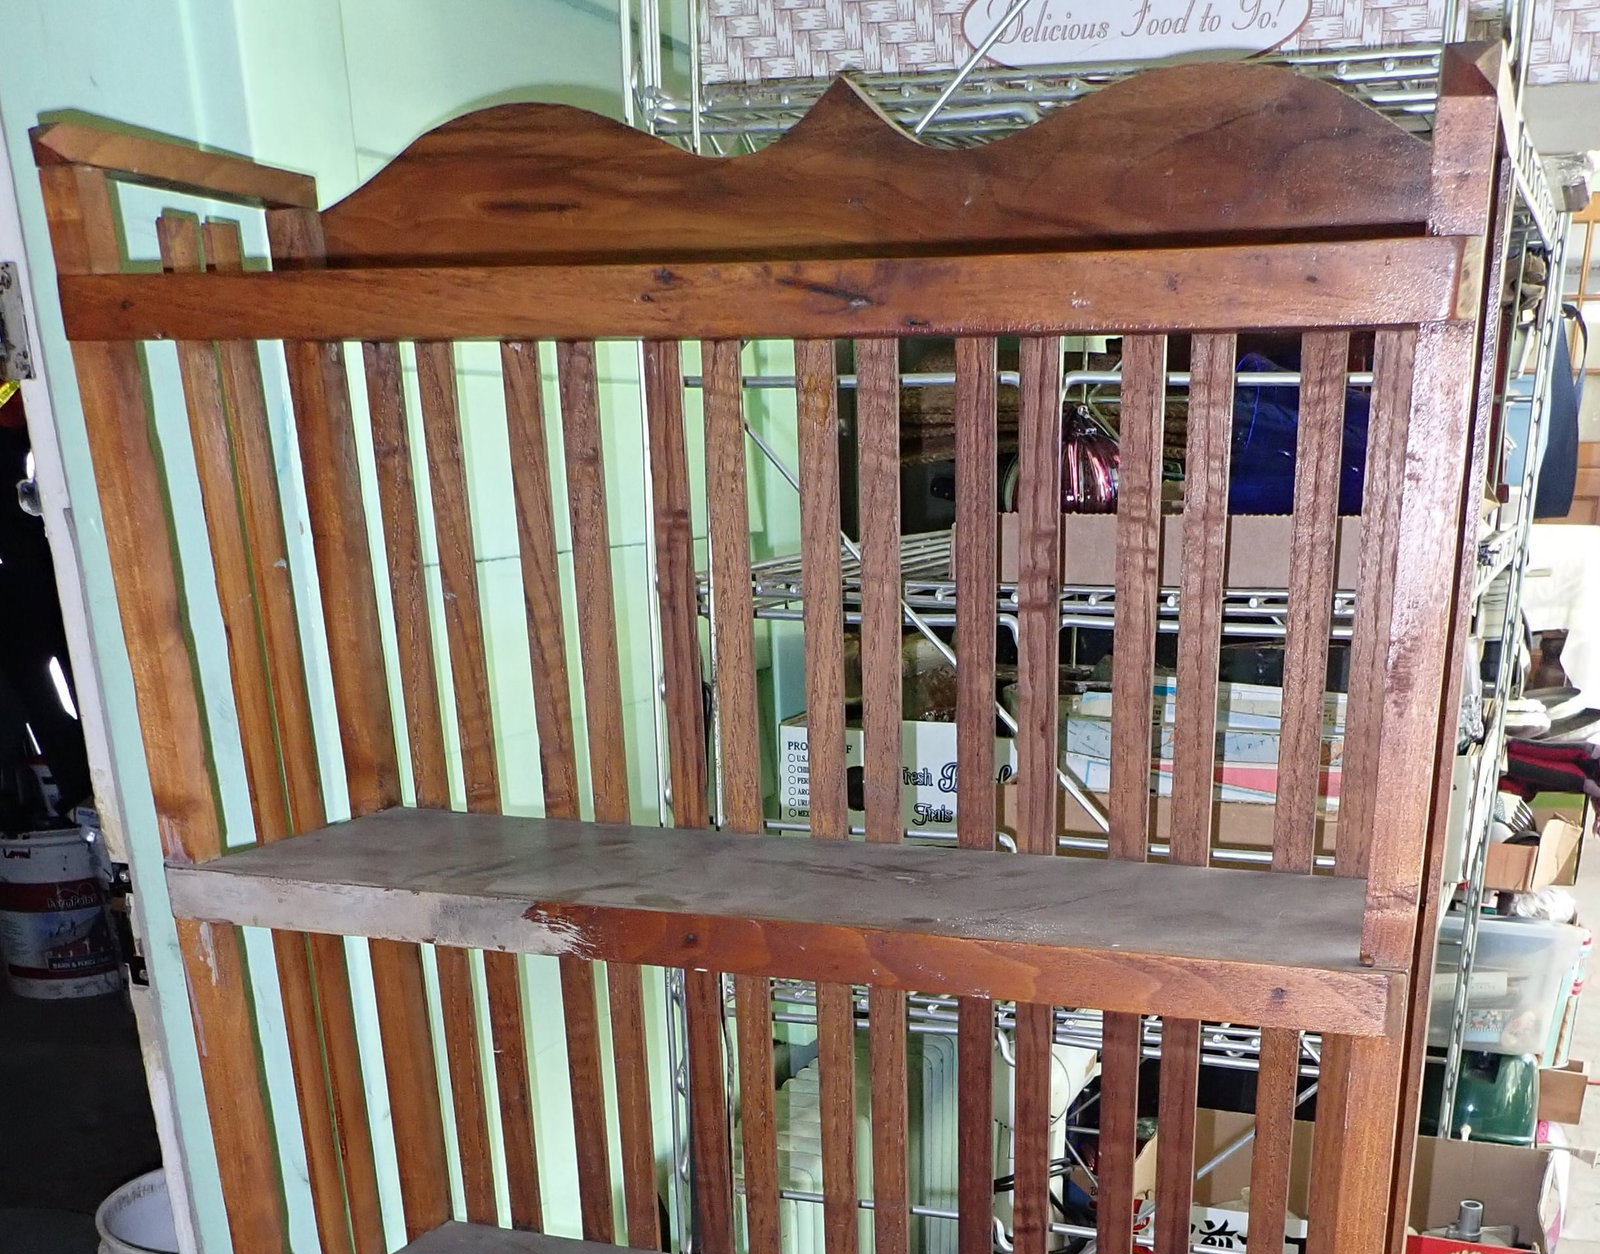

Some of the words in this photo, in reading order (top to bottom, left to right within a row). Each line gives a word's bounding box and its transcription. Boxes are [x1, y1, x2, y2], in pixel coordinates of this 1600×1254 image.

[987, 0, 1110, 44] Delicious
[1121, 0, 1192, 37] Food
[1199, 9, 1222, 32] to
[1231, 0, 1283, 31] Go!
[788, 741, 809, 751] PRO
